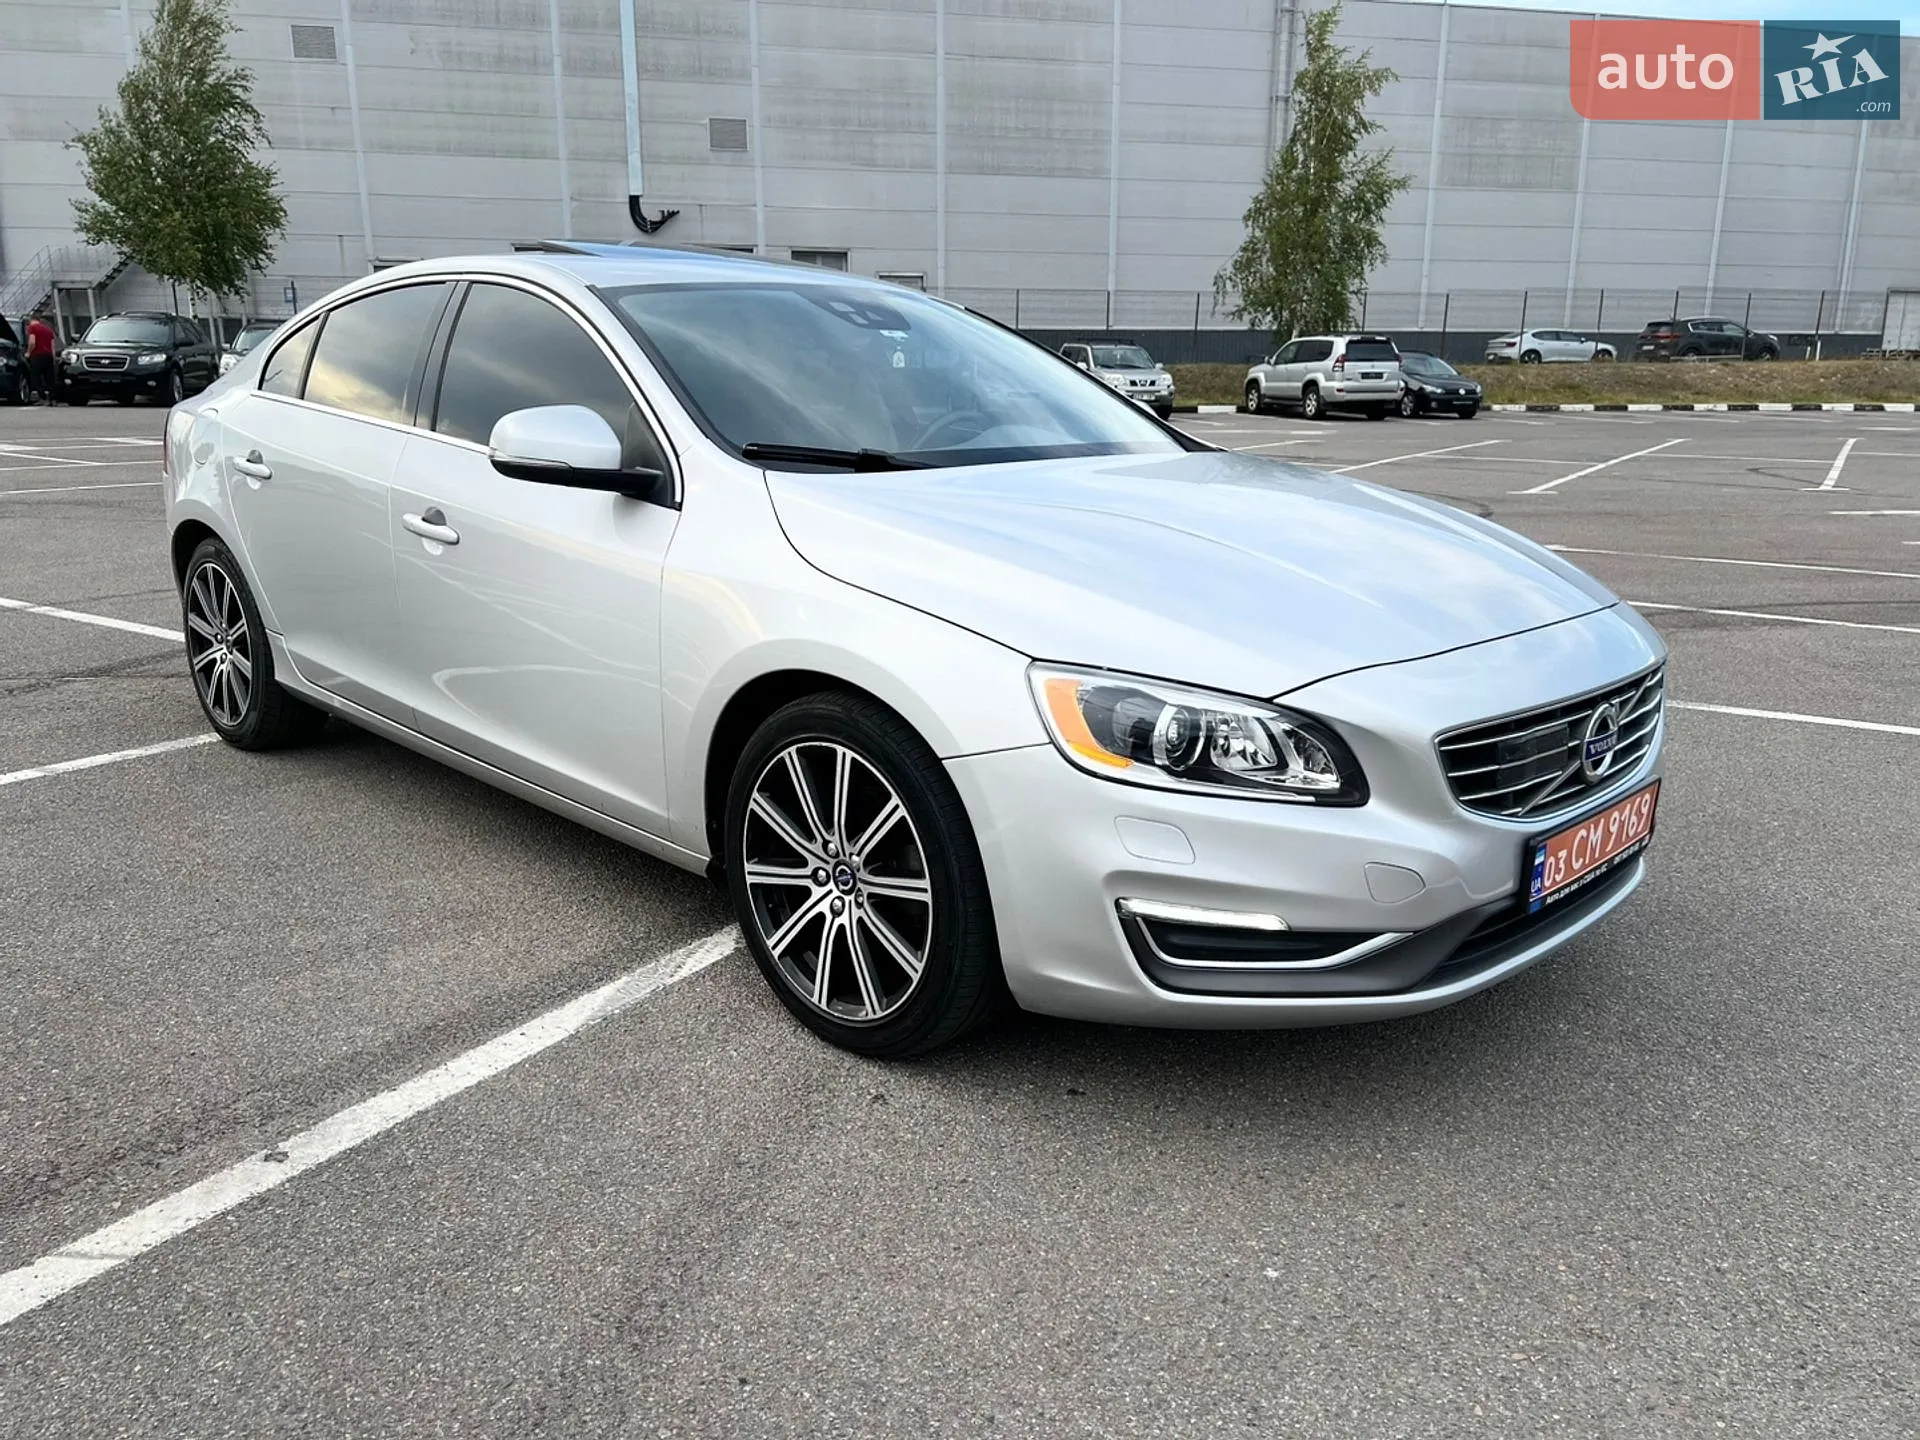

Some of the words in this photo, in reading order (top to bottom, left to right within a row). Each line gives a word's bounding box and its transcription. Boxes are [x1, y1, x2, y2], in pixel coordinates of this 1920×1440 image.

[1544, 849, 1568, 887] 03
[1571, 818, 1604, 870] CM
[1606, 793, 1650, 851] 9169
